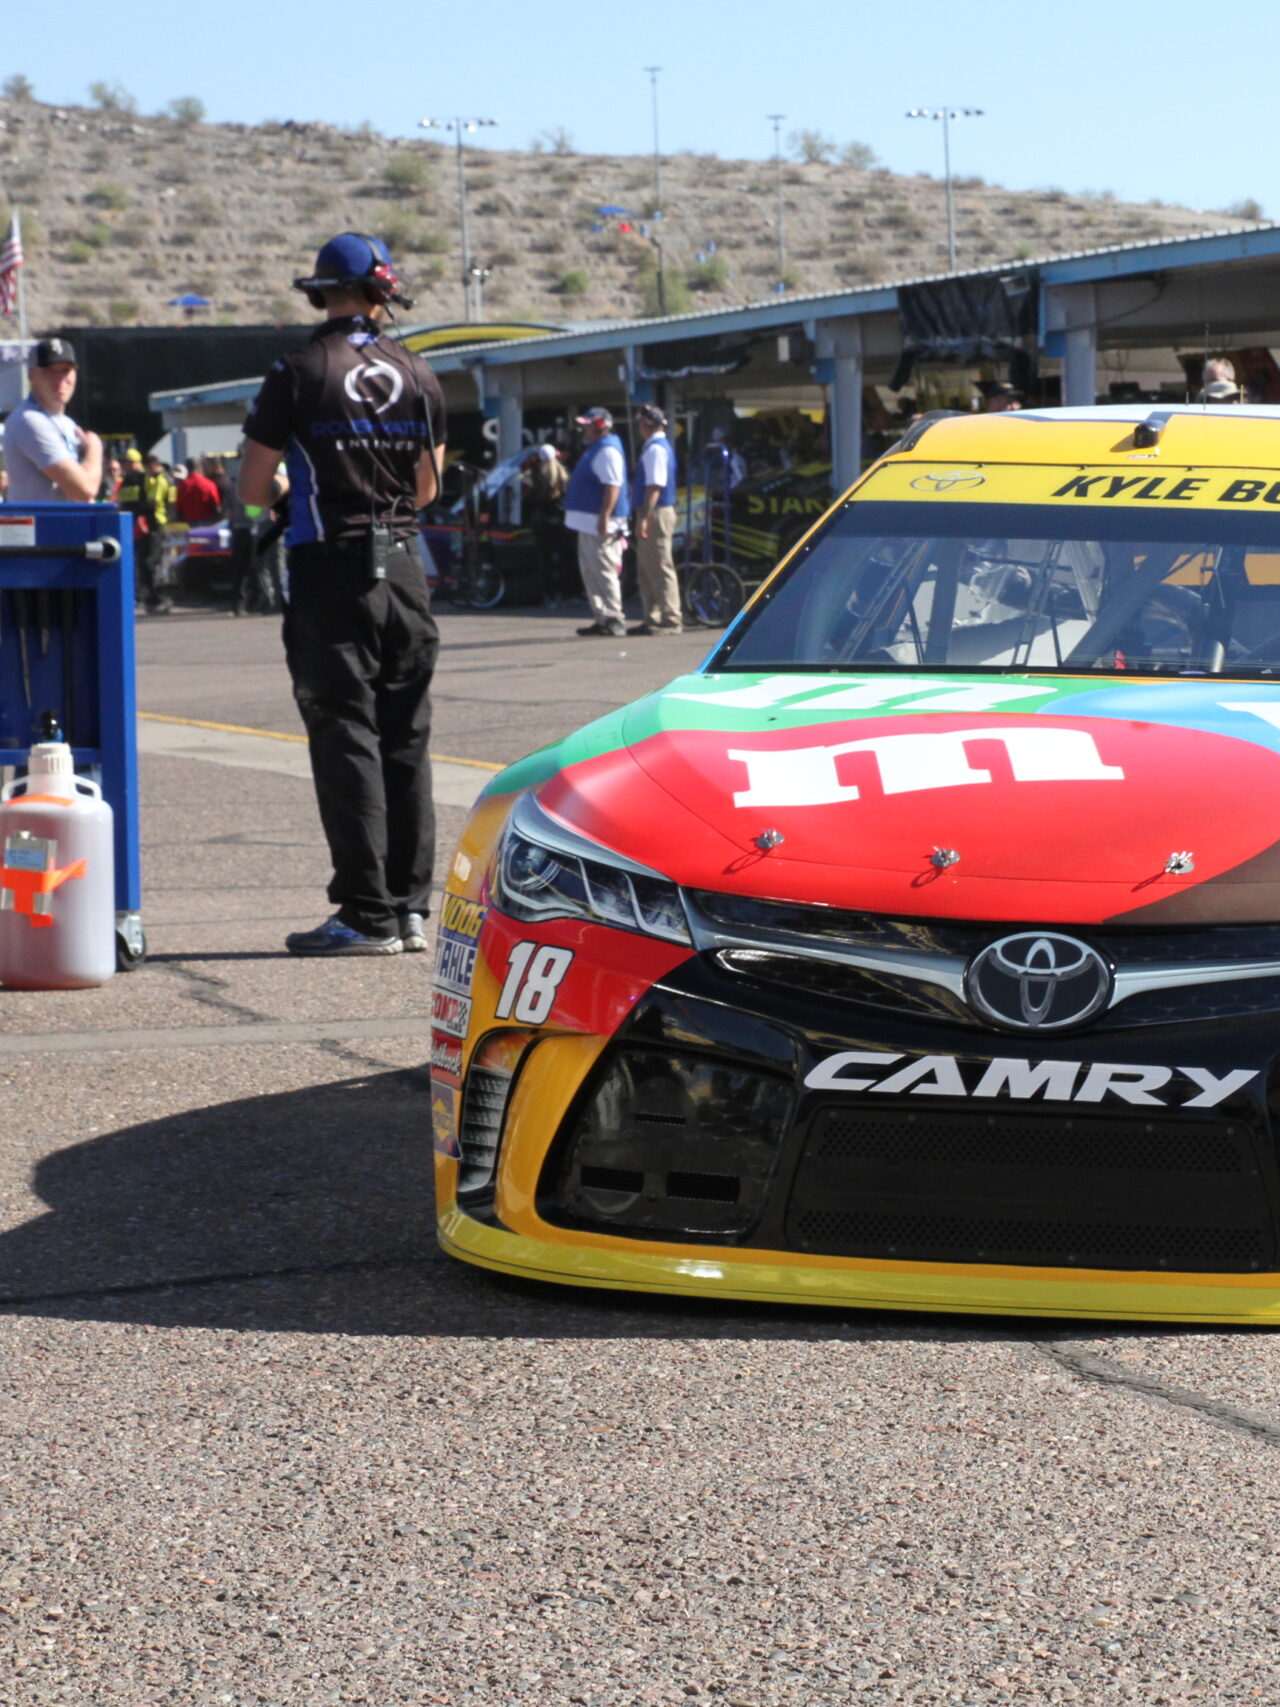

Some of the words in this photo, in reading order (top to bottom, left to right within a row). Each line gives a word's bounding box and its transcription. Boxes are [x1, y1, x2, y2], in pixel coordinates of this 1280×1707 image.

[1051, 475, 1209, 501] KYLE
[727, 726, 1125, 809] m
[495, 940, 575, 1026] 18
[803, 1051, 1261, 1108] CAMRY
